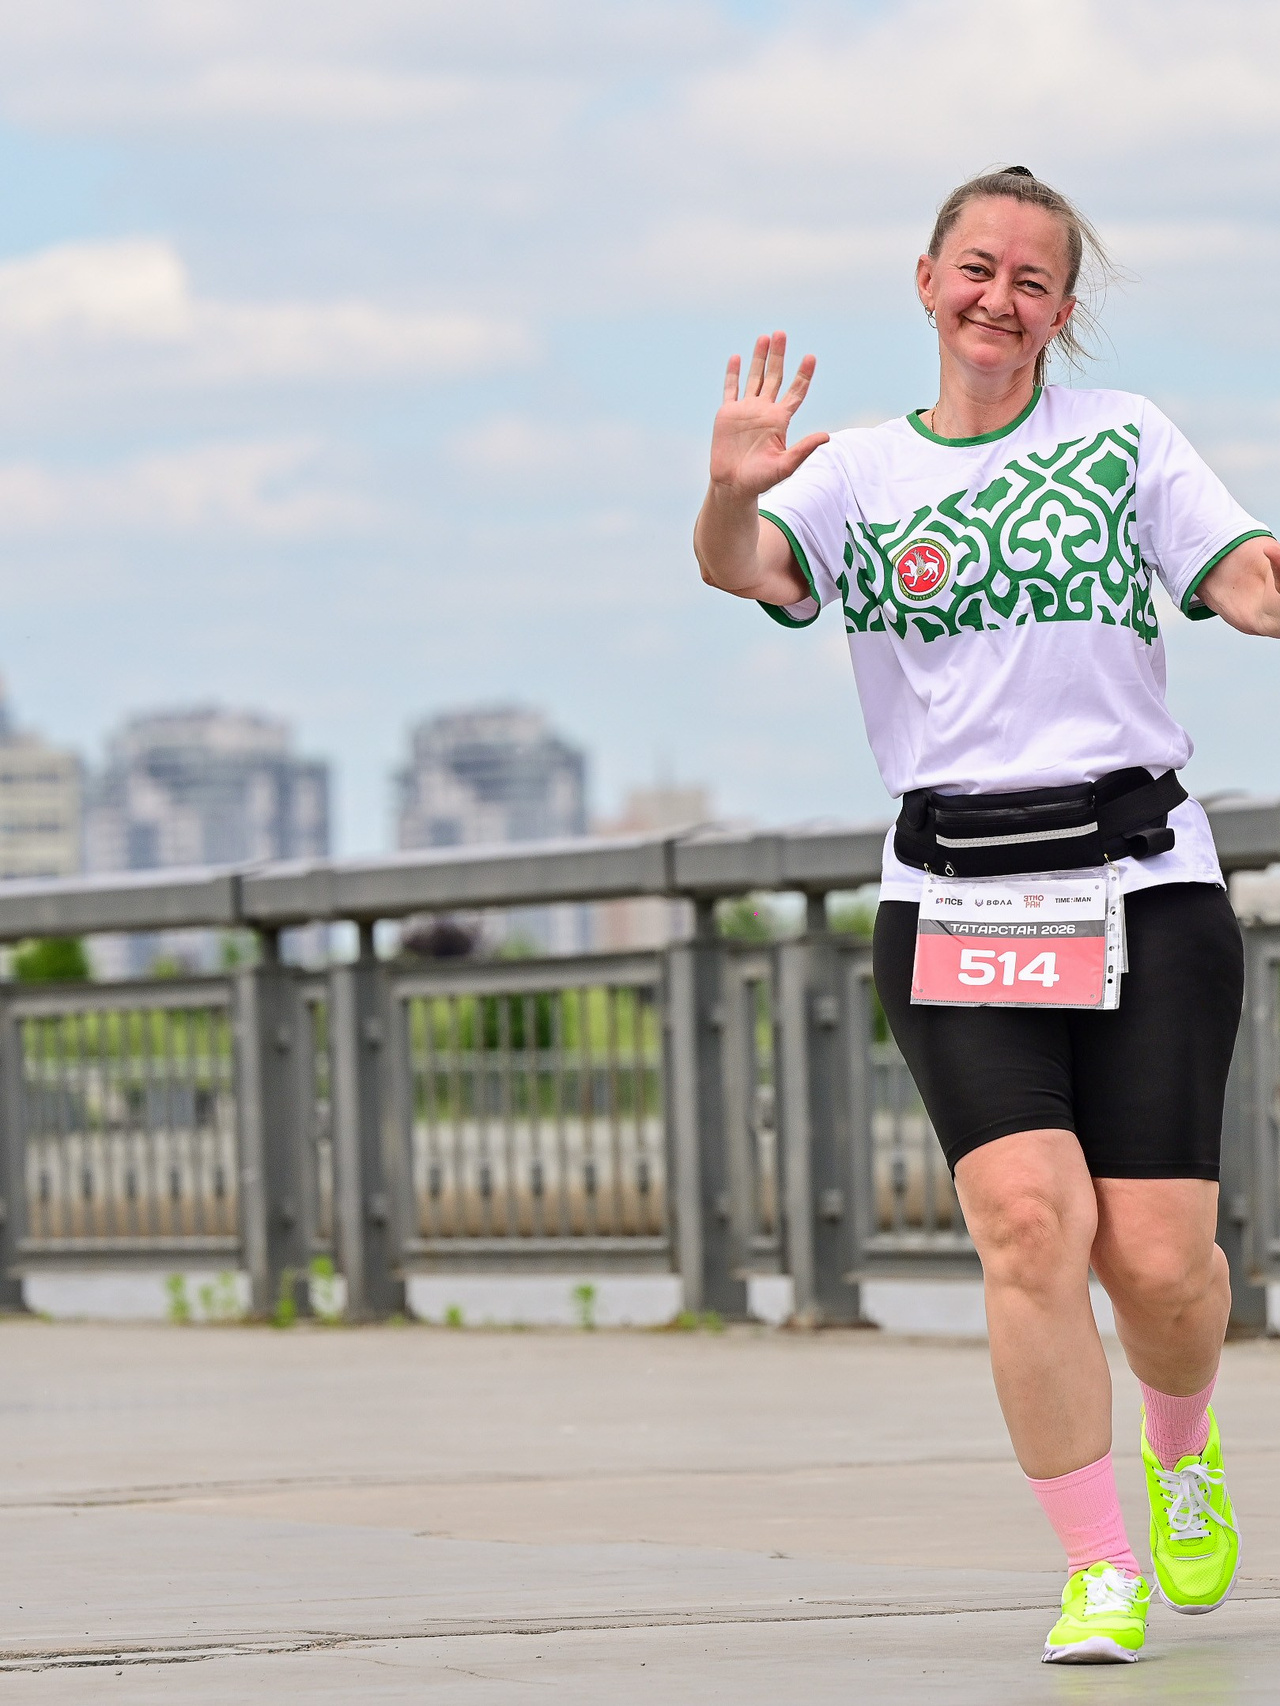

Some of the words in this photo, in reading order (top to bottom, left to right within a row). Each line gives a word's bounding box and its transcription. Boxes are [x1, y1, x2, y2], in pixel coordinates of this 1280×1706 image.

[944, 897, 963, 906] ПСБ
[950, 923, 1037, 935] ТАТАРСТАН
[1041, 924, 1076, 935] 2026
[957, 948, 1060, 988] 514
